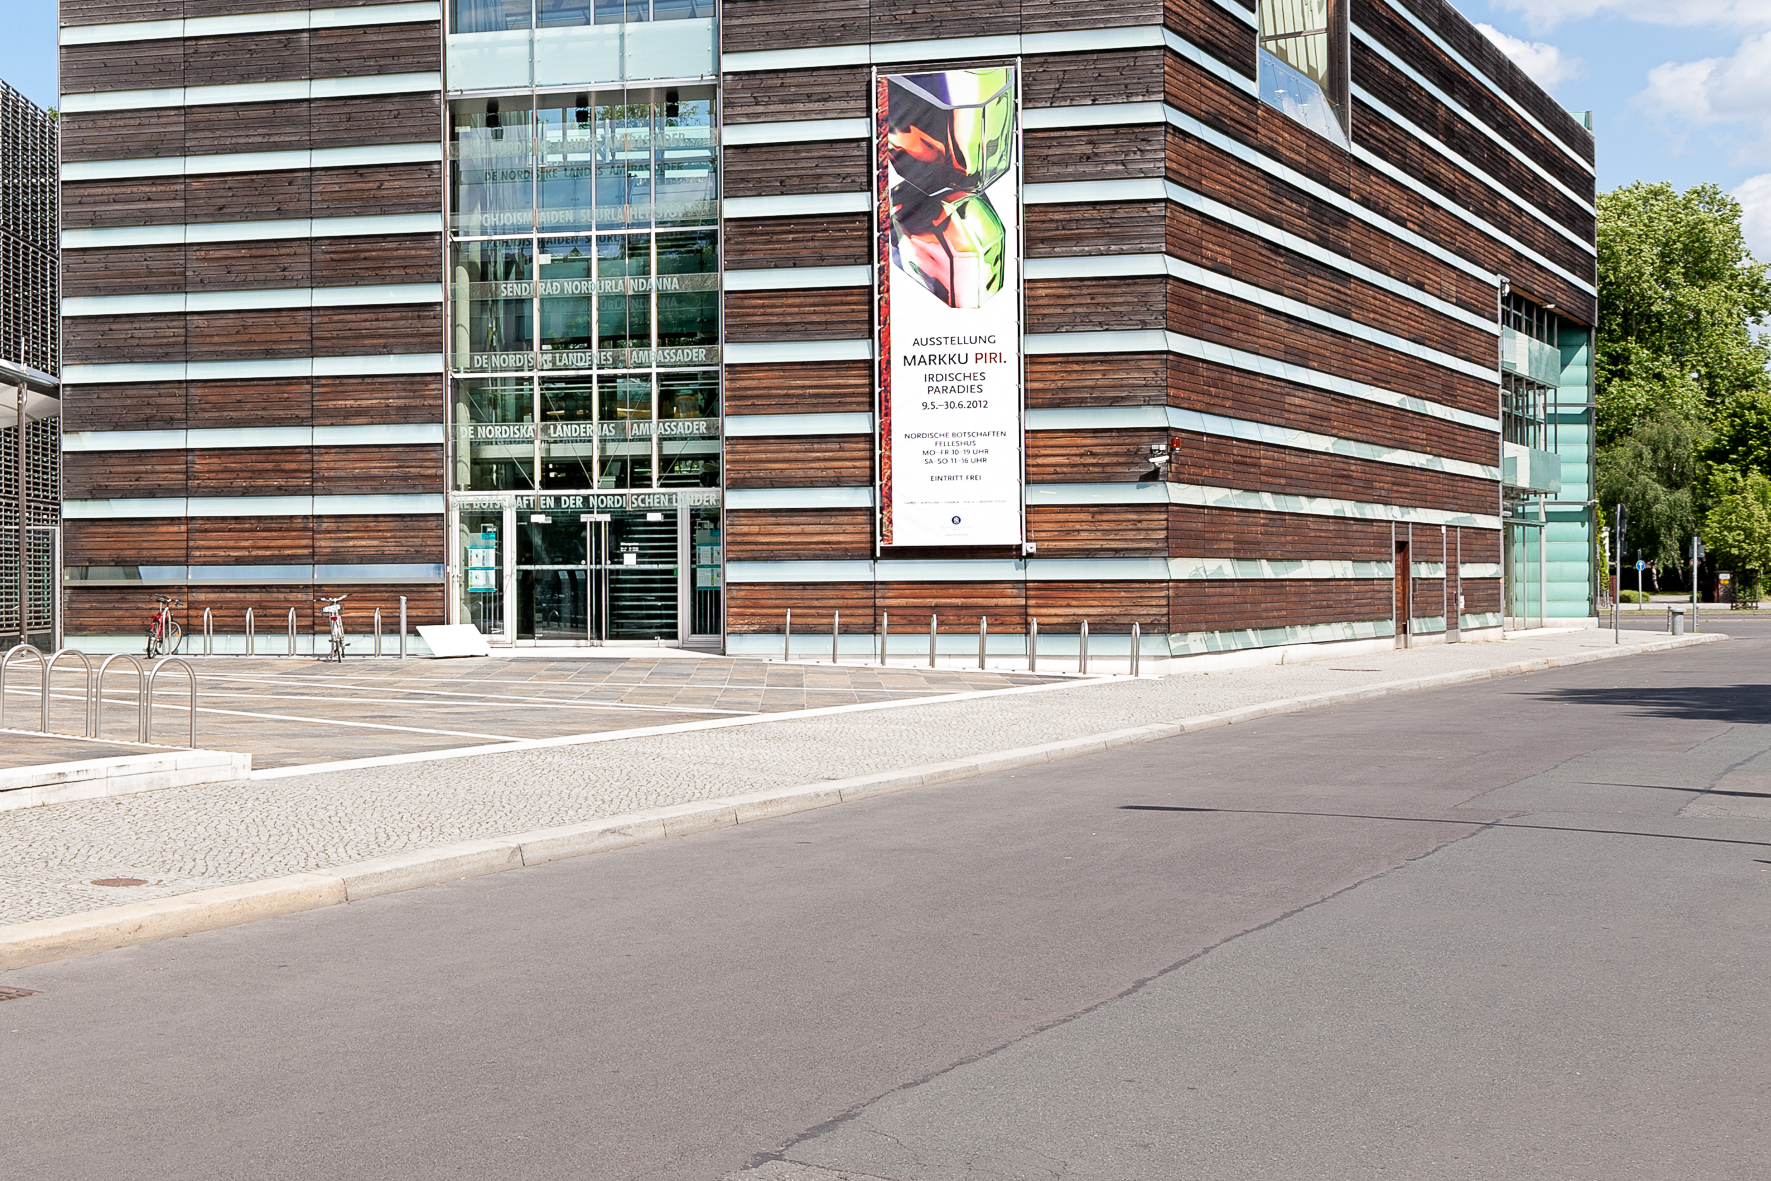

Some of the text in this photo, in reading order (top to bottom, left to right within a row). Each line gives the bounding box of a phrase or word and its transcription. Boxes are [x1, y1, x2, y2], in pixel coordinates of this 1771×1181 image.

[478, 210, 573, 227] POHJOISMAIDEN
[501, 277, 680, 297] SENDIRÁÐ NORÐURLANDANNA
[912, 334, 997, 347] AUSSTELLUNG
[474, 348, 707, 368] DE NORDISKE LANDENES AMBASSADER
[903, 351, 1007, 367] MARKKU PIRI.
[924, 371, 986, 383] IRDISCHES
[927, 384, 984, 395] PARADIES
[460, 421, 707, 439] DE NORDISKA LÄNDERNAS AMBASSADER
[951, 430, 1007, 438] BOTSCHAFTEN
[930, 474, 963, 482] EINTRITT
[561, 495, 584, 509] DER
[589, 493, 669, 508] NORDISCHEN
